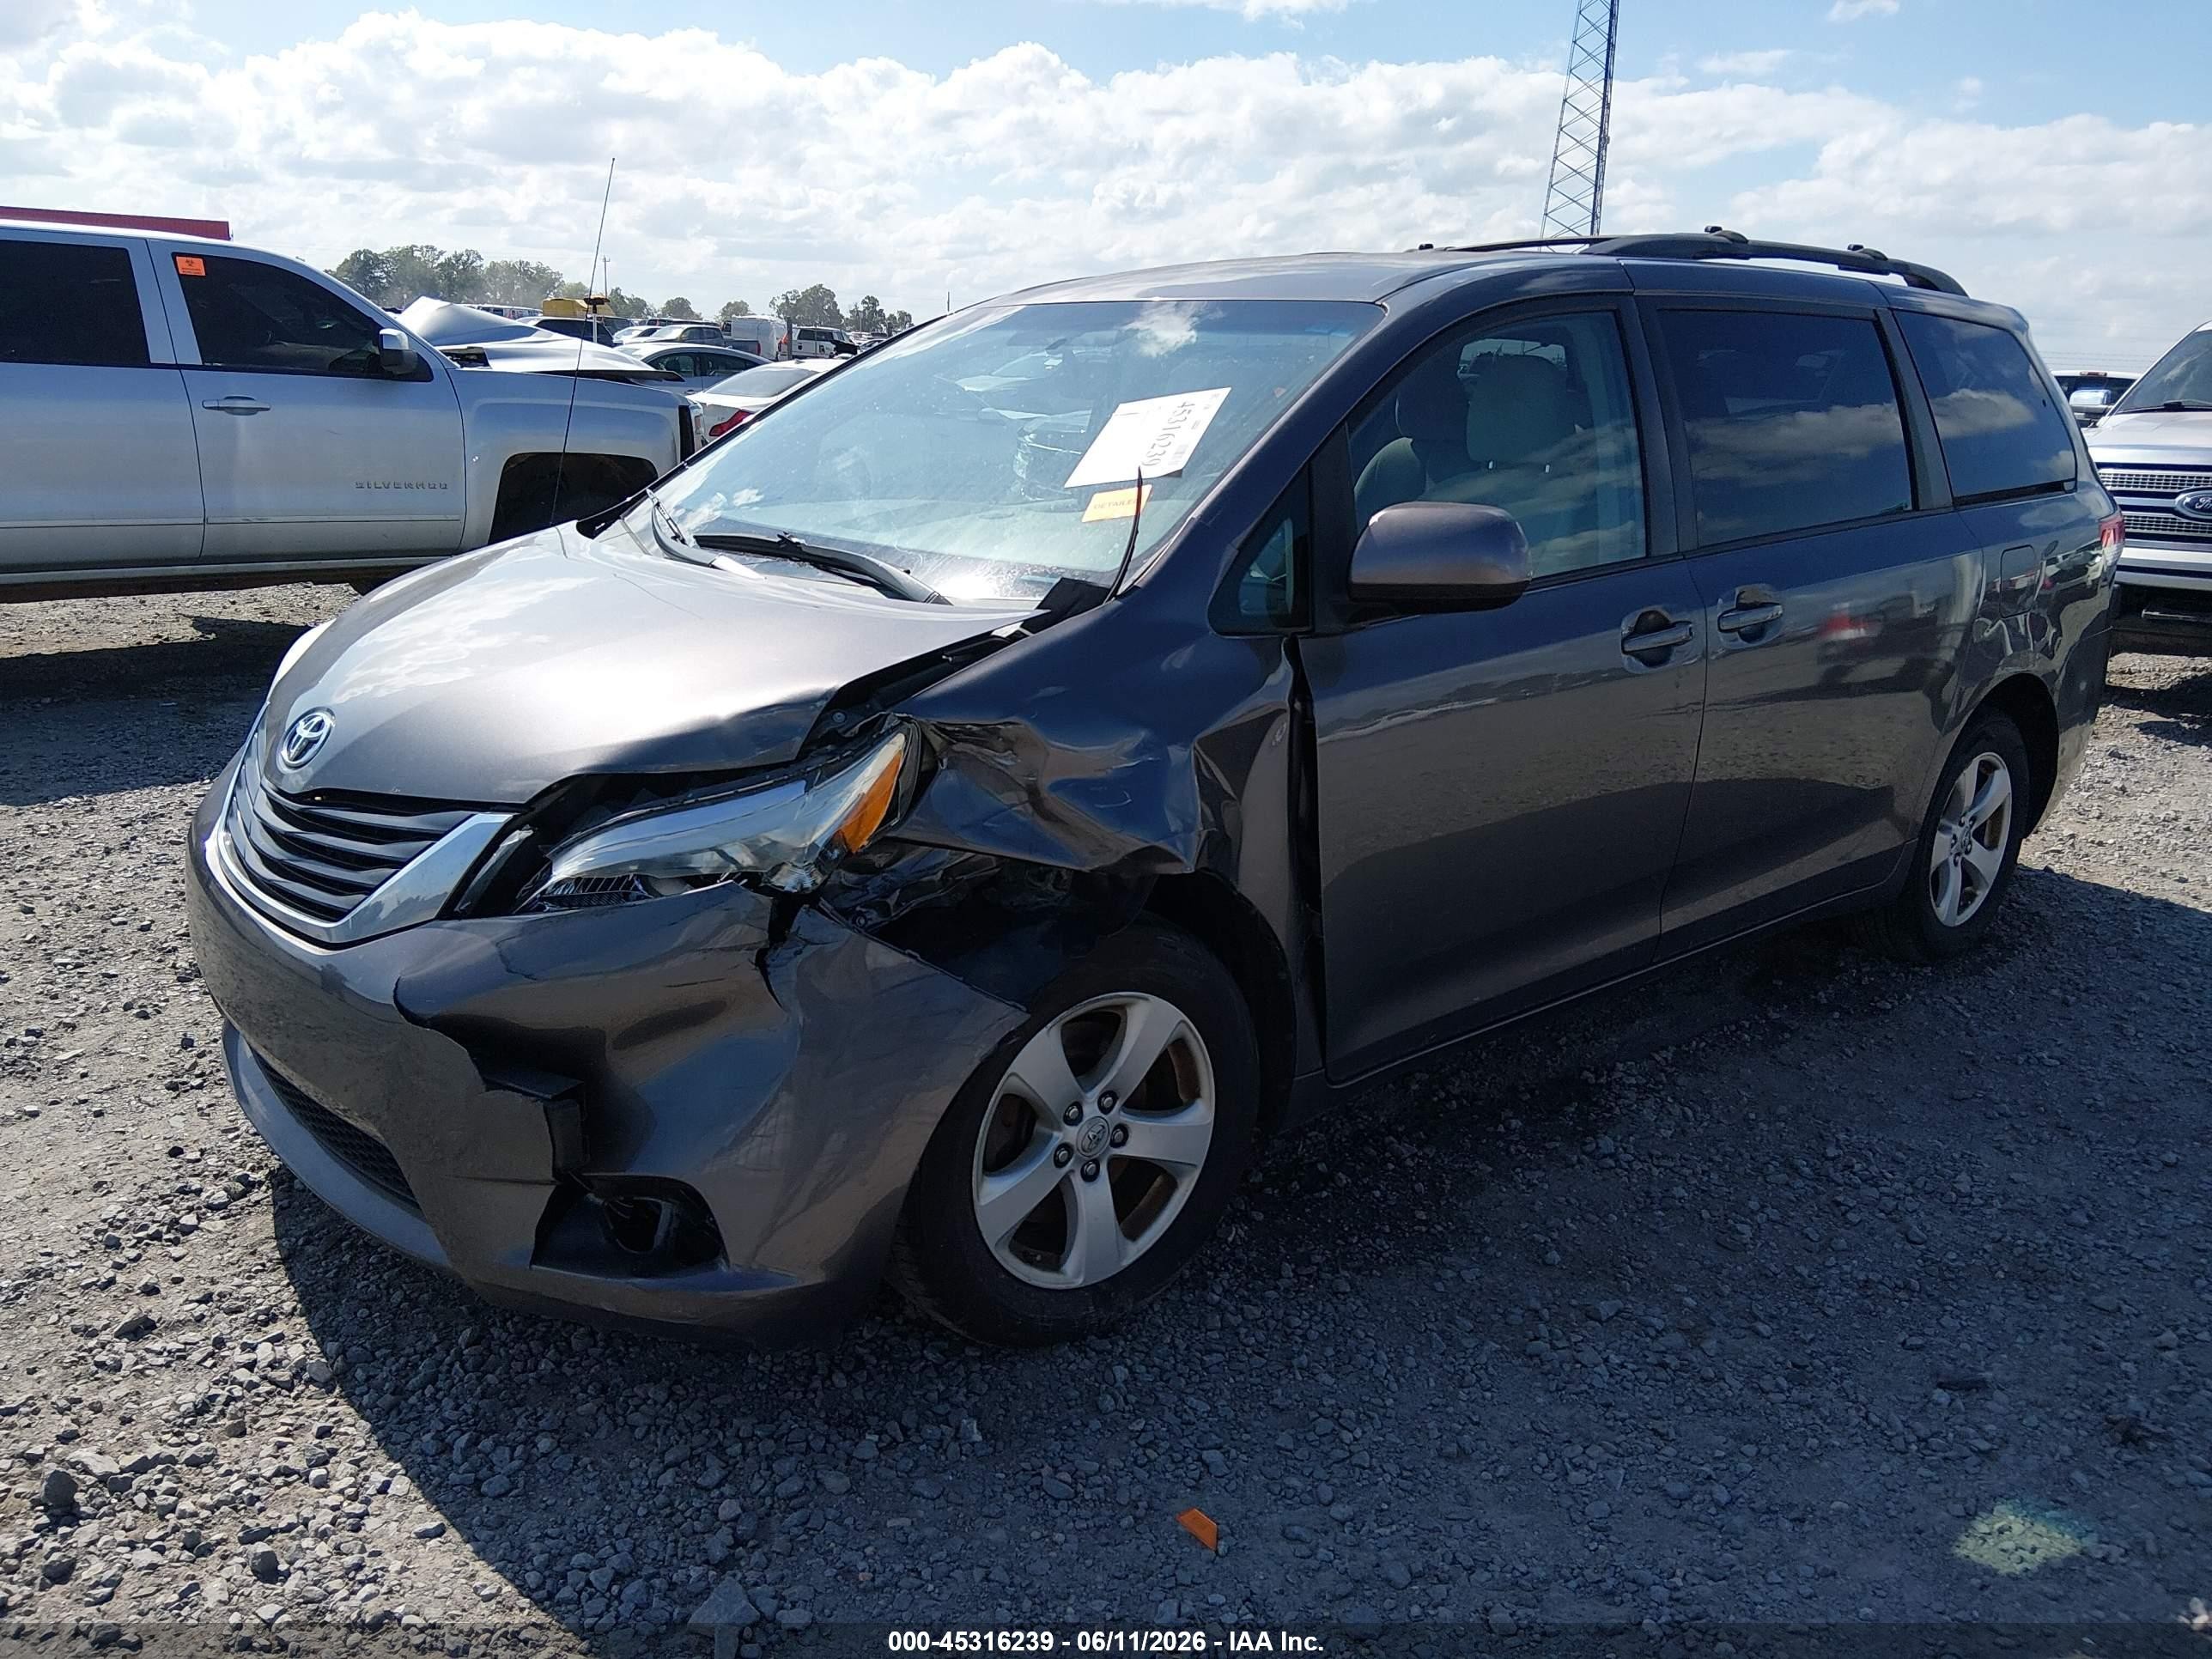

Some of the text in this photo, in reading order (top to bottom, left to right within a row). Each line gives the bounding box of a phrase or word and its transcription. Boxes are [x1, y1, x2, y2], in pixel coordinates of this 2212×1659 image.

[1141, 401, 1196, 466] 45316239
[355, 480, 448, 489] SILVERADO
[1093, 498, 1137, 509] DETAILE
